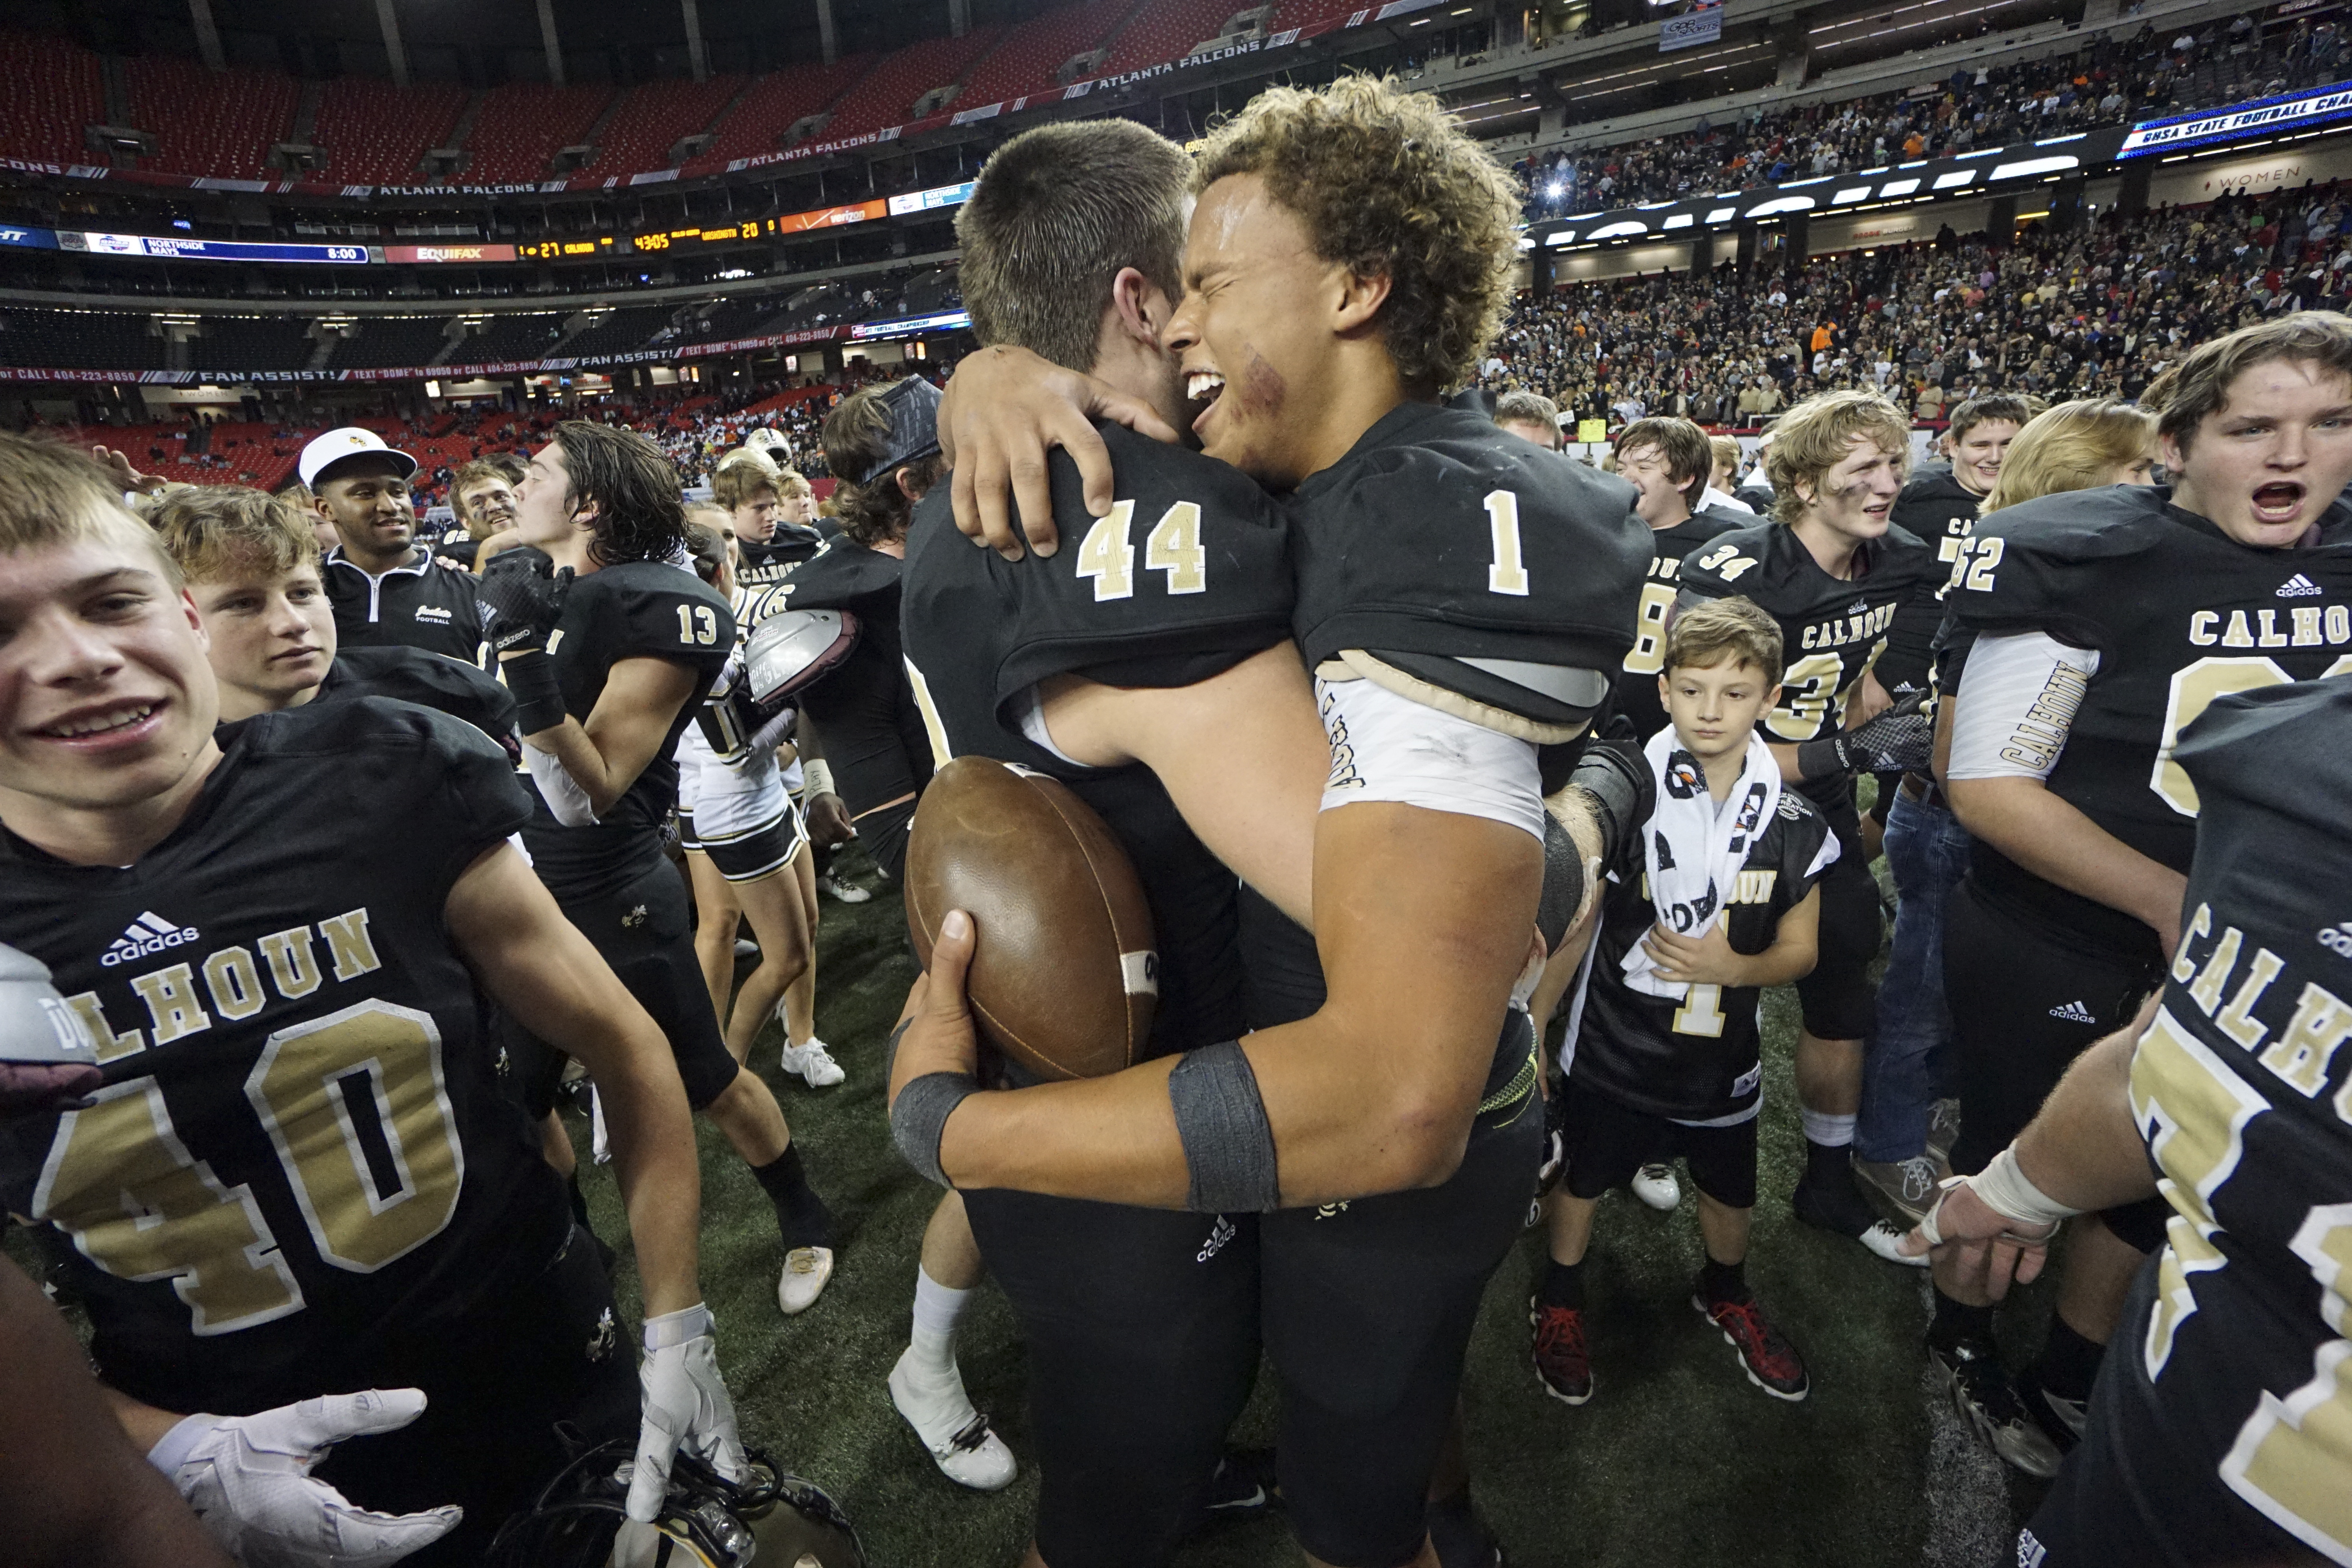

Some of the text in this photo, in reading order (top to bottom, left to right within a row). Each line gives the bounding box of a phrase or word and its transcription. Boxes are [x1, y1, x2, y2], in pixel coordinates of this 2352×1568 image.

[1670, 20, 1695, 32] GPB
[1679, 22, 1719, 34] SPORTS
[1099, 40, 1259, 89] ATLANTA FALCONS
[2185, 118, 2229, 135] STATE
[2233, 103, 2307, 127] FOOTBALL
[2315, 92, 2352, 111] CHA
[751, 133, 877, 166] ATLANTA FALCONS
[2220, 167, 2300, 188] WOMEN
[381, 184, 535, 195] ATLANTA FALCONS
[925, 186, 961, 200] NORTHSIDE
[927, 198, 944, 207] MAYS
[830, 209, 865, 223] verizon
[742, 222, 759, 238] 20
[148, 240, 205, 250] NORTHSIDE
[635, 233, 669, 250] 43:05
[151, 247, 179, 255] MAYS
[328, 248, 356, 259] 8:00
[417, 248, 482, 262] EQUIFAX
[541, 242, 559, 258] 27
[686, 345, 701, 356] TEXT
[768, 335, 784, 345] CALL
[582, 350, 673, 366] FAN ASSIST!
[17, 369, 50, 379] CALL
[54, 370, 135, 381] 404-223-8850
[200, 371, 336, 381] FAN ASSIST!
[354, 370, 375, 379] TEXT
[465, 365, 485, 374] CALL
[443, 530, 470, 545] 82
[1484, 489, 1529, 596] 1
[1076, 499, 1206, 602] 44
[1699, 545, 1758, 582] 34
[1951, 537, 2004, 592] 62
[2276, 587, 2322, 597] adidas
[752, 584, 796, 627] 16
[1848, 604, 1867, 614] adidas
[677, 604, 716, 644] 13
[2189, 605, 2350, 648] CALHO
[497, 629, 530, 649] adizero
[1999, 660, 2089, 770] CALHOUN
[1835, 739, 1849, 767] adizero
[101, 926, 199, 967] adidas
[2049, 1007, 2095, 1023] adidas
[32, 998, 465, 1336] 40
[1197, 1225, 1235, 1262] adidas
